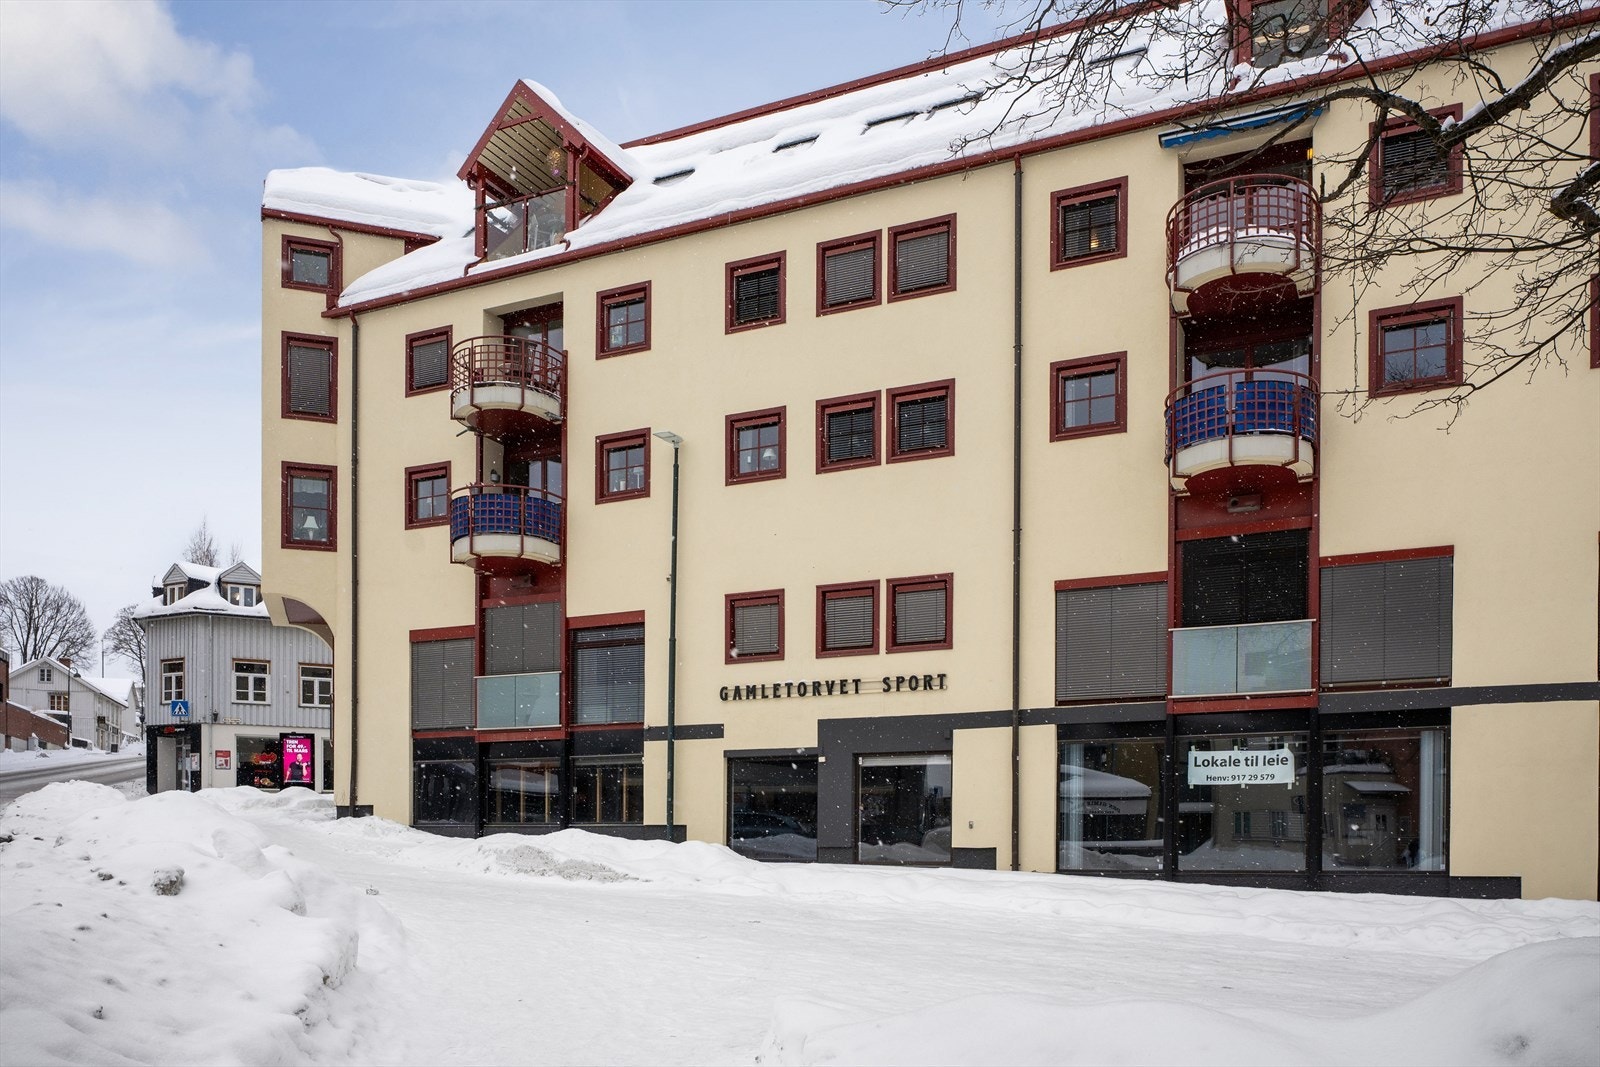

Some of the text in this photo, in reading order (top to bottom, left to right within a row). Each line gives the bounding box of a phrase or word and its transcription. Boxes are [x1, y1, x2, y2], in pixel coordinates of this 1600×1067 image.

[719, 673, 947, 702] GAMLETORVET SPORT
[1193, 754, 1289, 768] Lokale til leie
[1206, 774, 1230, 782] Henv:
[1231, 774, 1246, 782] 917
[1260, 773, 1275, 781] 579
